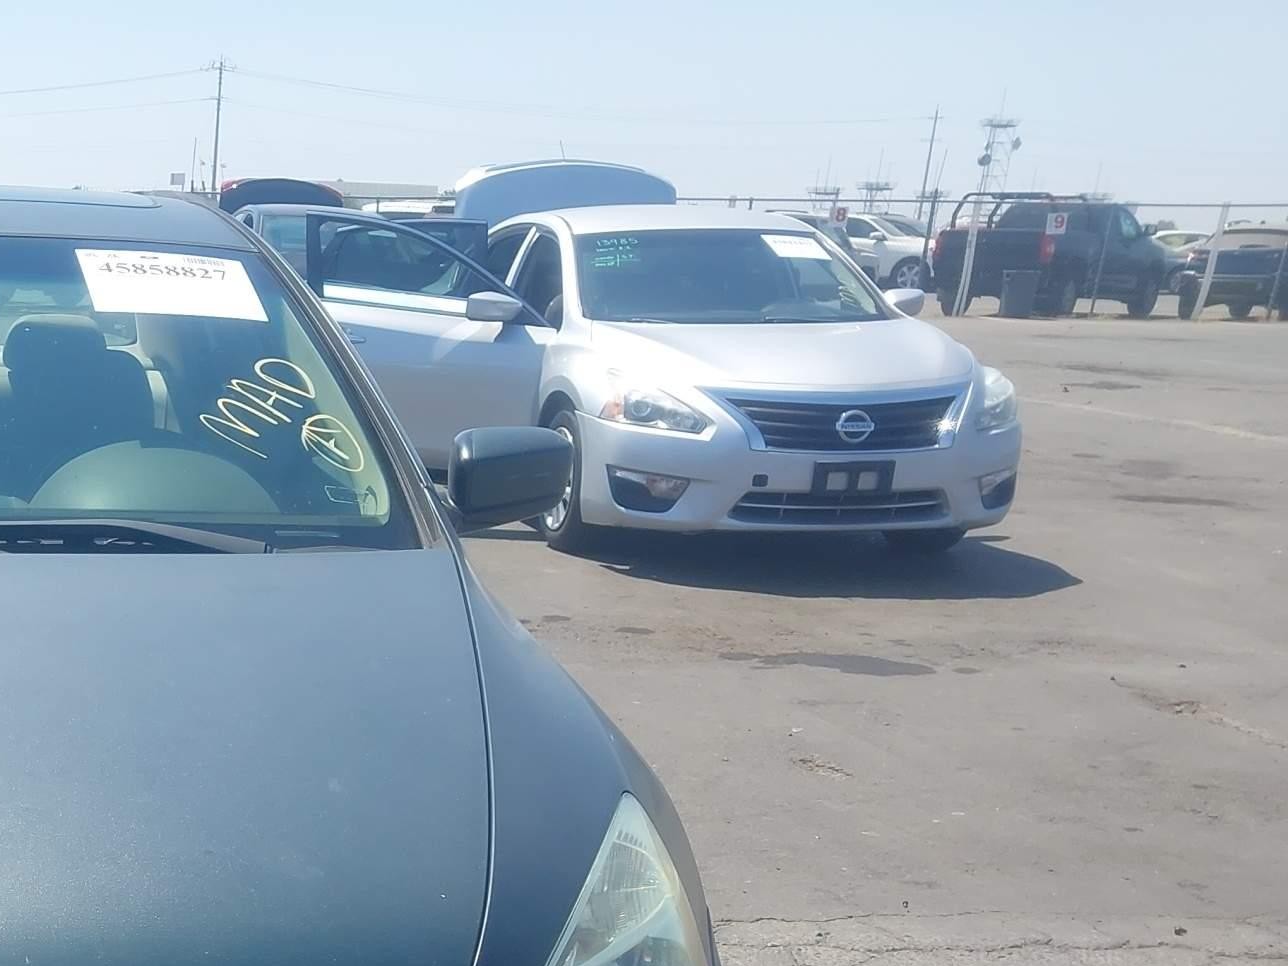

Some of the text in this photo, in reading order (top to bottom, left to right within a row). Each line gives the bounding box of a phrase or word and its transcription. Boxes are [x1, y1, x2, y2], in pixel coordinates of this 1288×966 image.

[836, 207, 847, 222] 8
[1055, 214, 1065, 229] 9
[98, 261, 226, 281] 45858827
